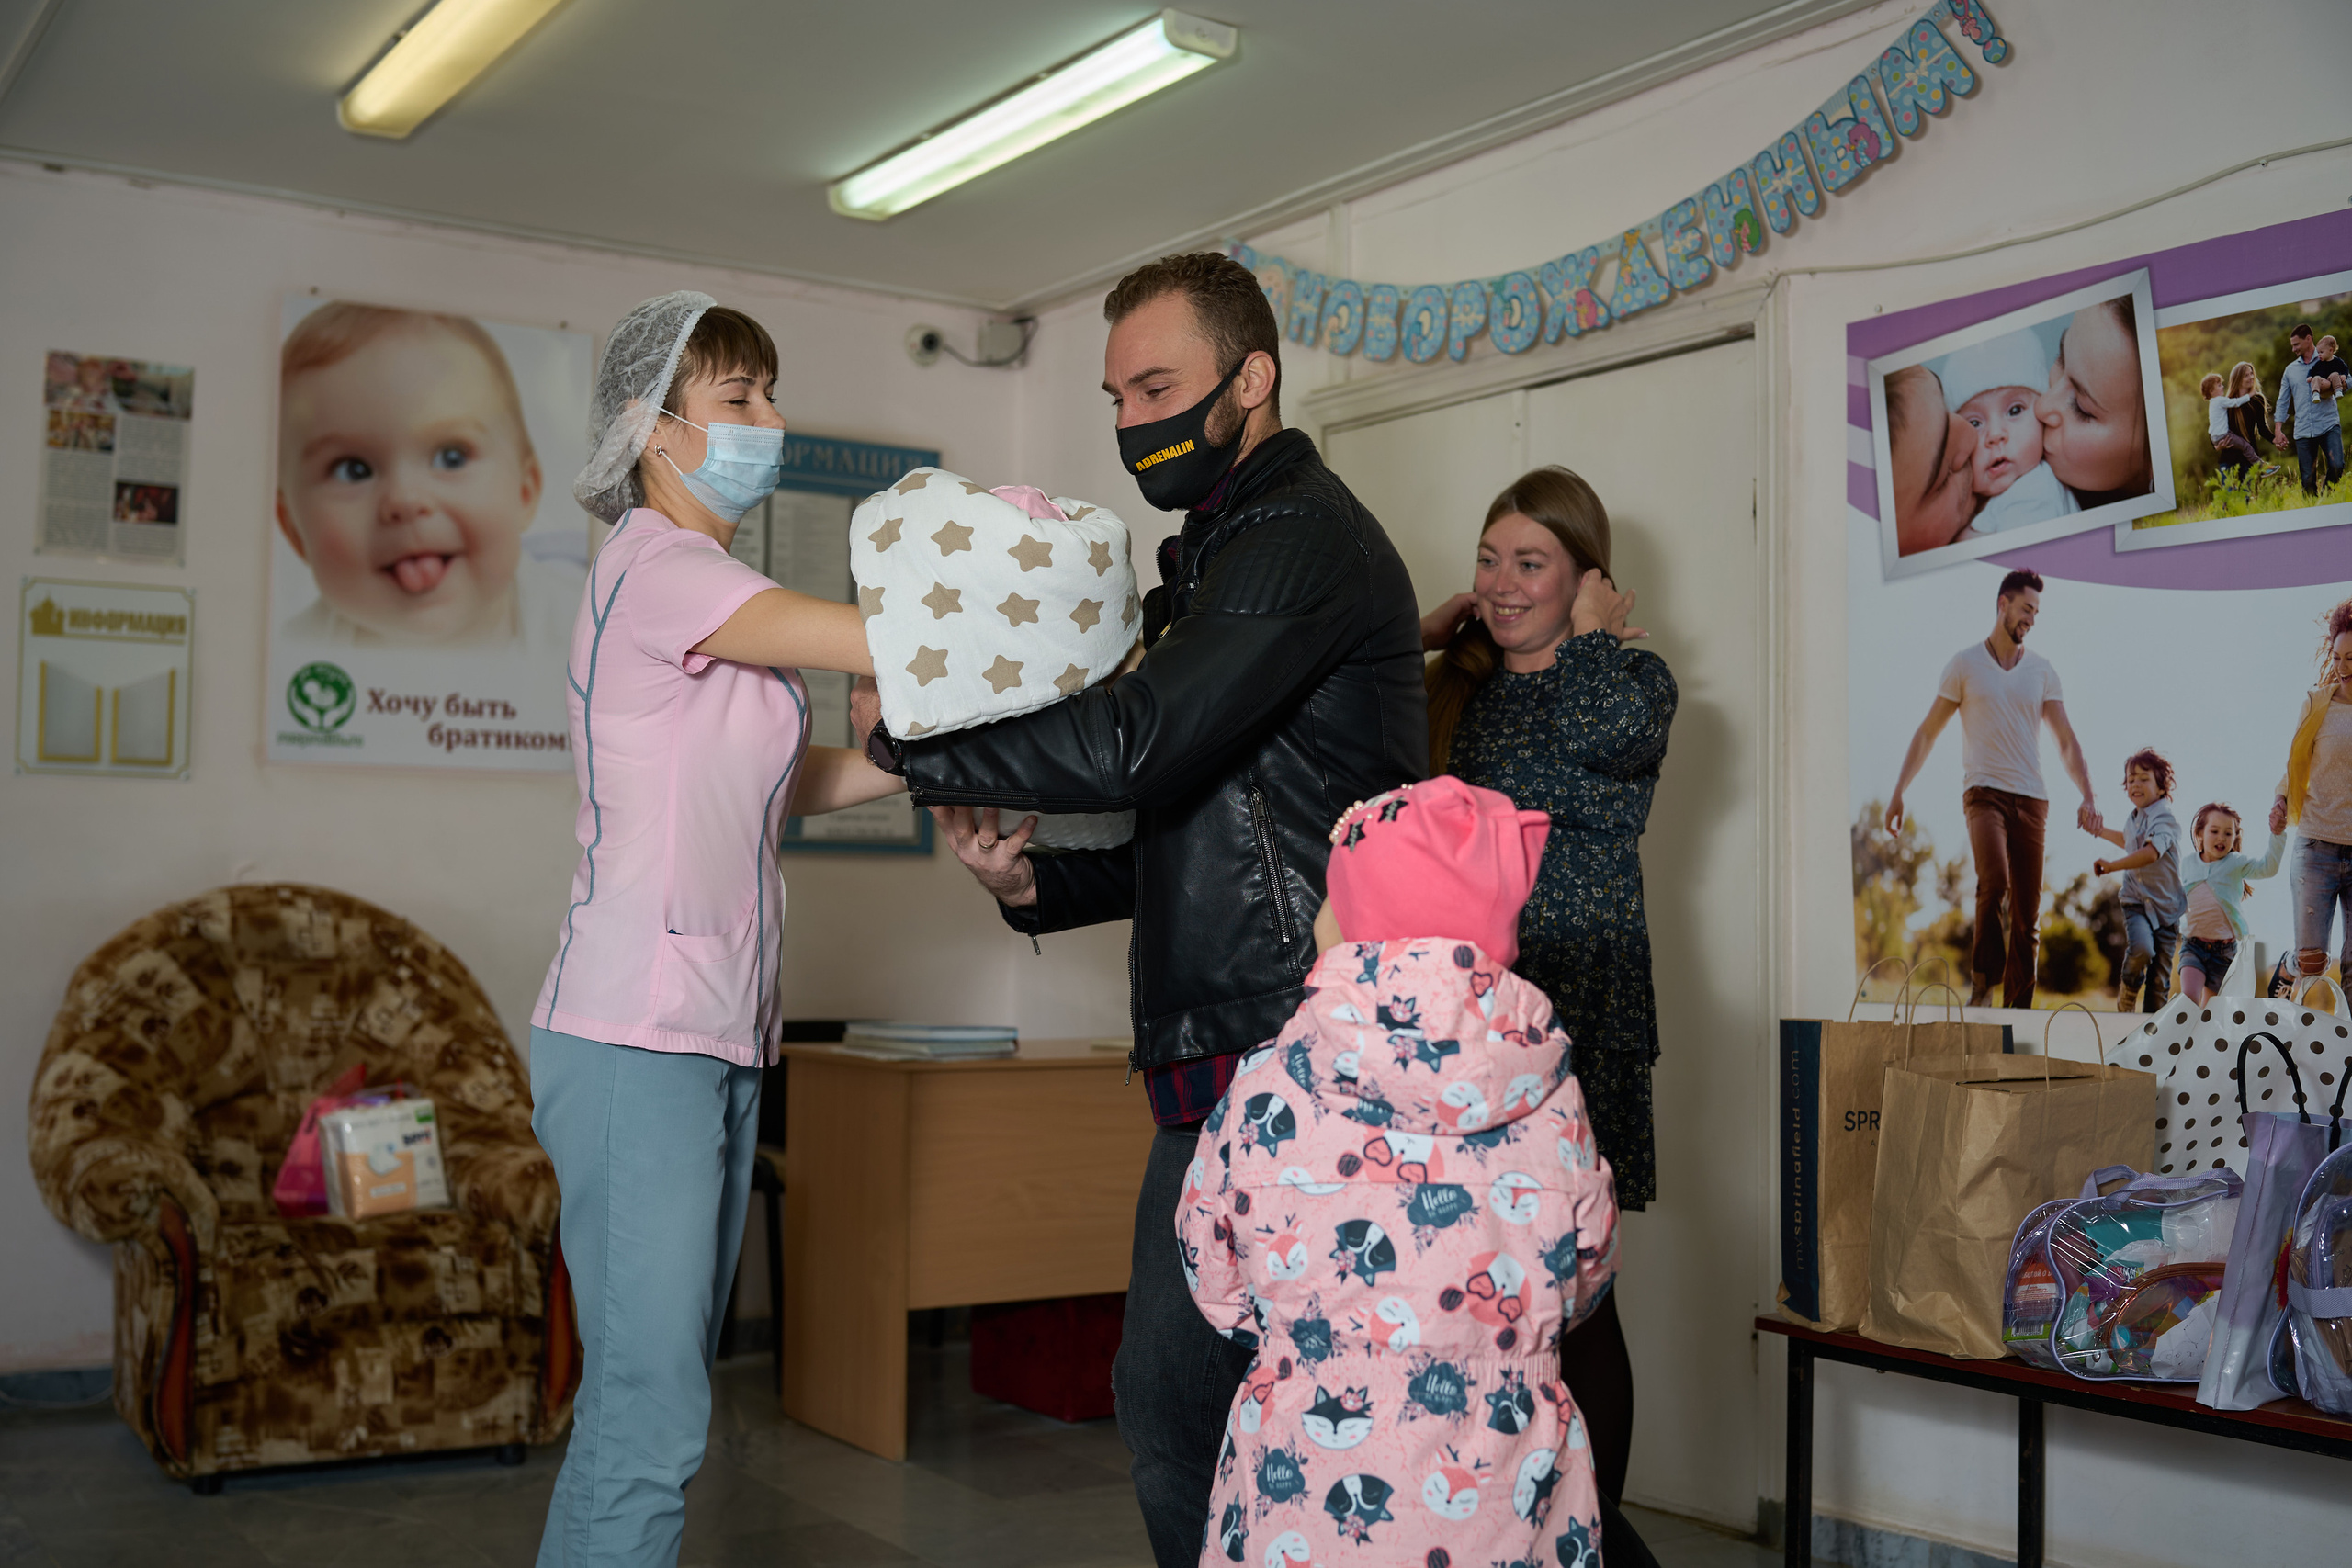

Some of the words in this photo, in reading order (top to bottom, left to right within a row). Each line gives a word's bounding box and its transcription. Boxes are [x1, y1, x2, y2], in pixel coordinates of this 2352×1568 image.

[1136, 439, 1195, 472] ADRENALIN
[69, 607, 187, 640] ИНФОРМАЦИЯ
[367, 687, 438, 723] Хочу
[443, 692, 518, 720] быть
[426, 721, 572, 754] братиком
[1421, 1187, 1458, 1211] Hello
[1426, 1373, 1458, 1395] Hello
[1267, 1462, 1294, 1483] Hello
